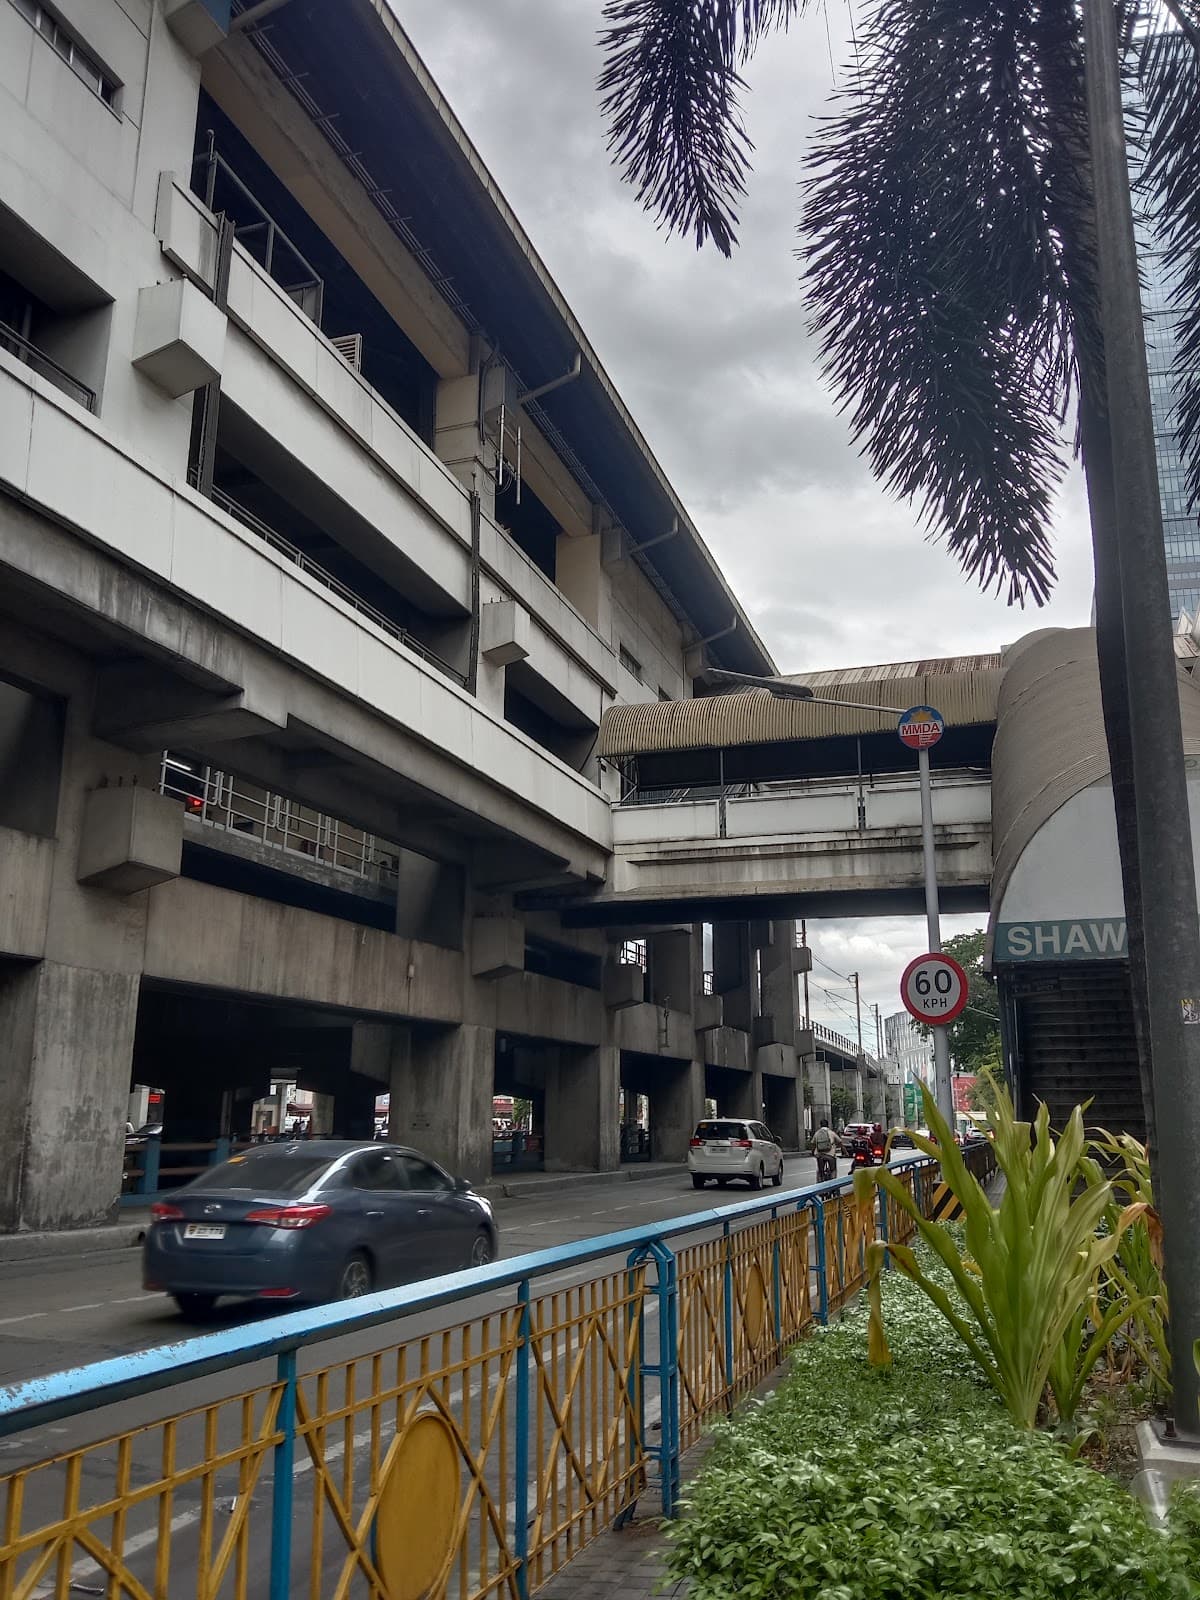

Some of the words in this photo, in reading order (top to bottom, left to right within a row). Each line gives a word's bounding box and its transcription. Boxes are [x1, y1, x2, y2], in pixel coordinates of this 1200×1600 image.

[901, 723, 940, 735] MMDA
[1007, 922, 1127, 957] SHAW
[915, 969, 952, 995] 60
[923, 998, 947, 1009] KPH
